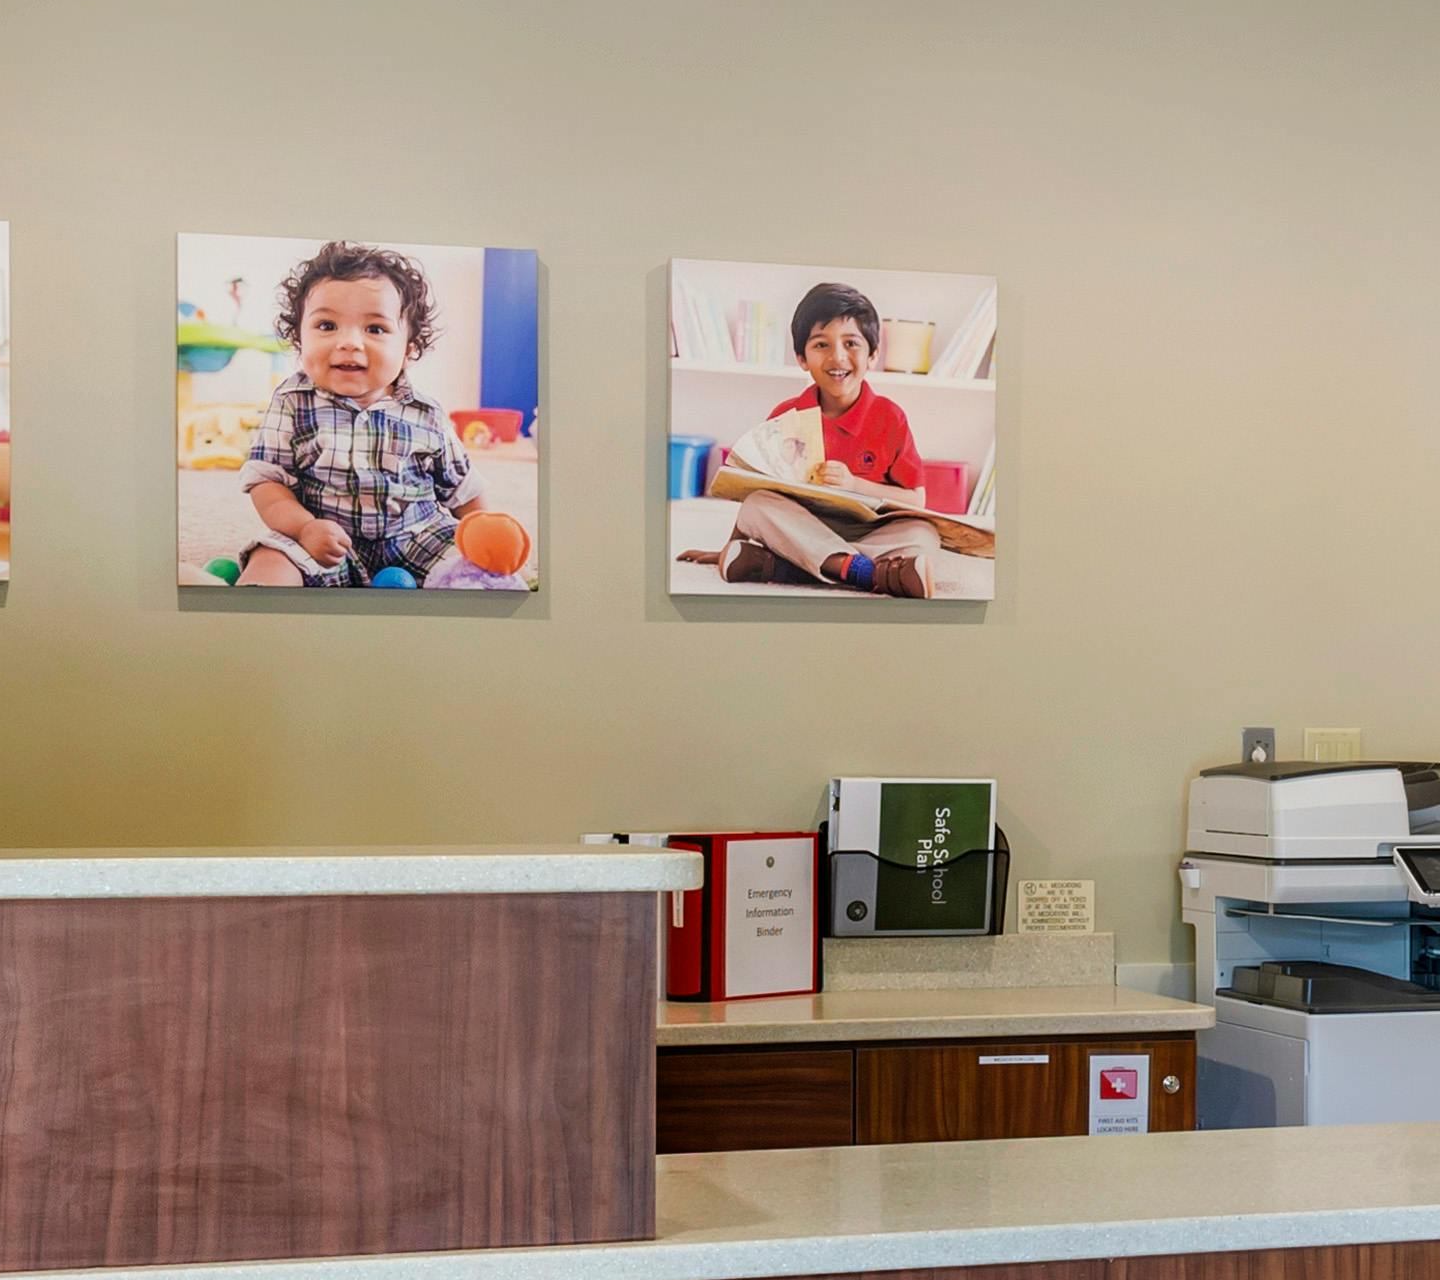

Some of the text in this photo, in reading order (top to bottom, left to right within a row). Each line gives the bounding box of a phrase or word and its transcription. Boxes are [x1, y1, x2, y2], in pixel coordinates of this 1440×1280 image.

[931, 807, 951, 904] Safe School
[747, 888, 793, 900] Emergency
[745, 907, 794, 918] Information
[756, 926, 783, 937] Binder
